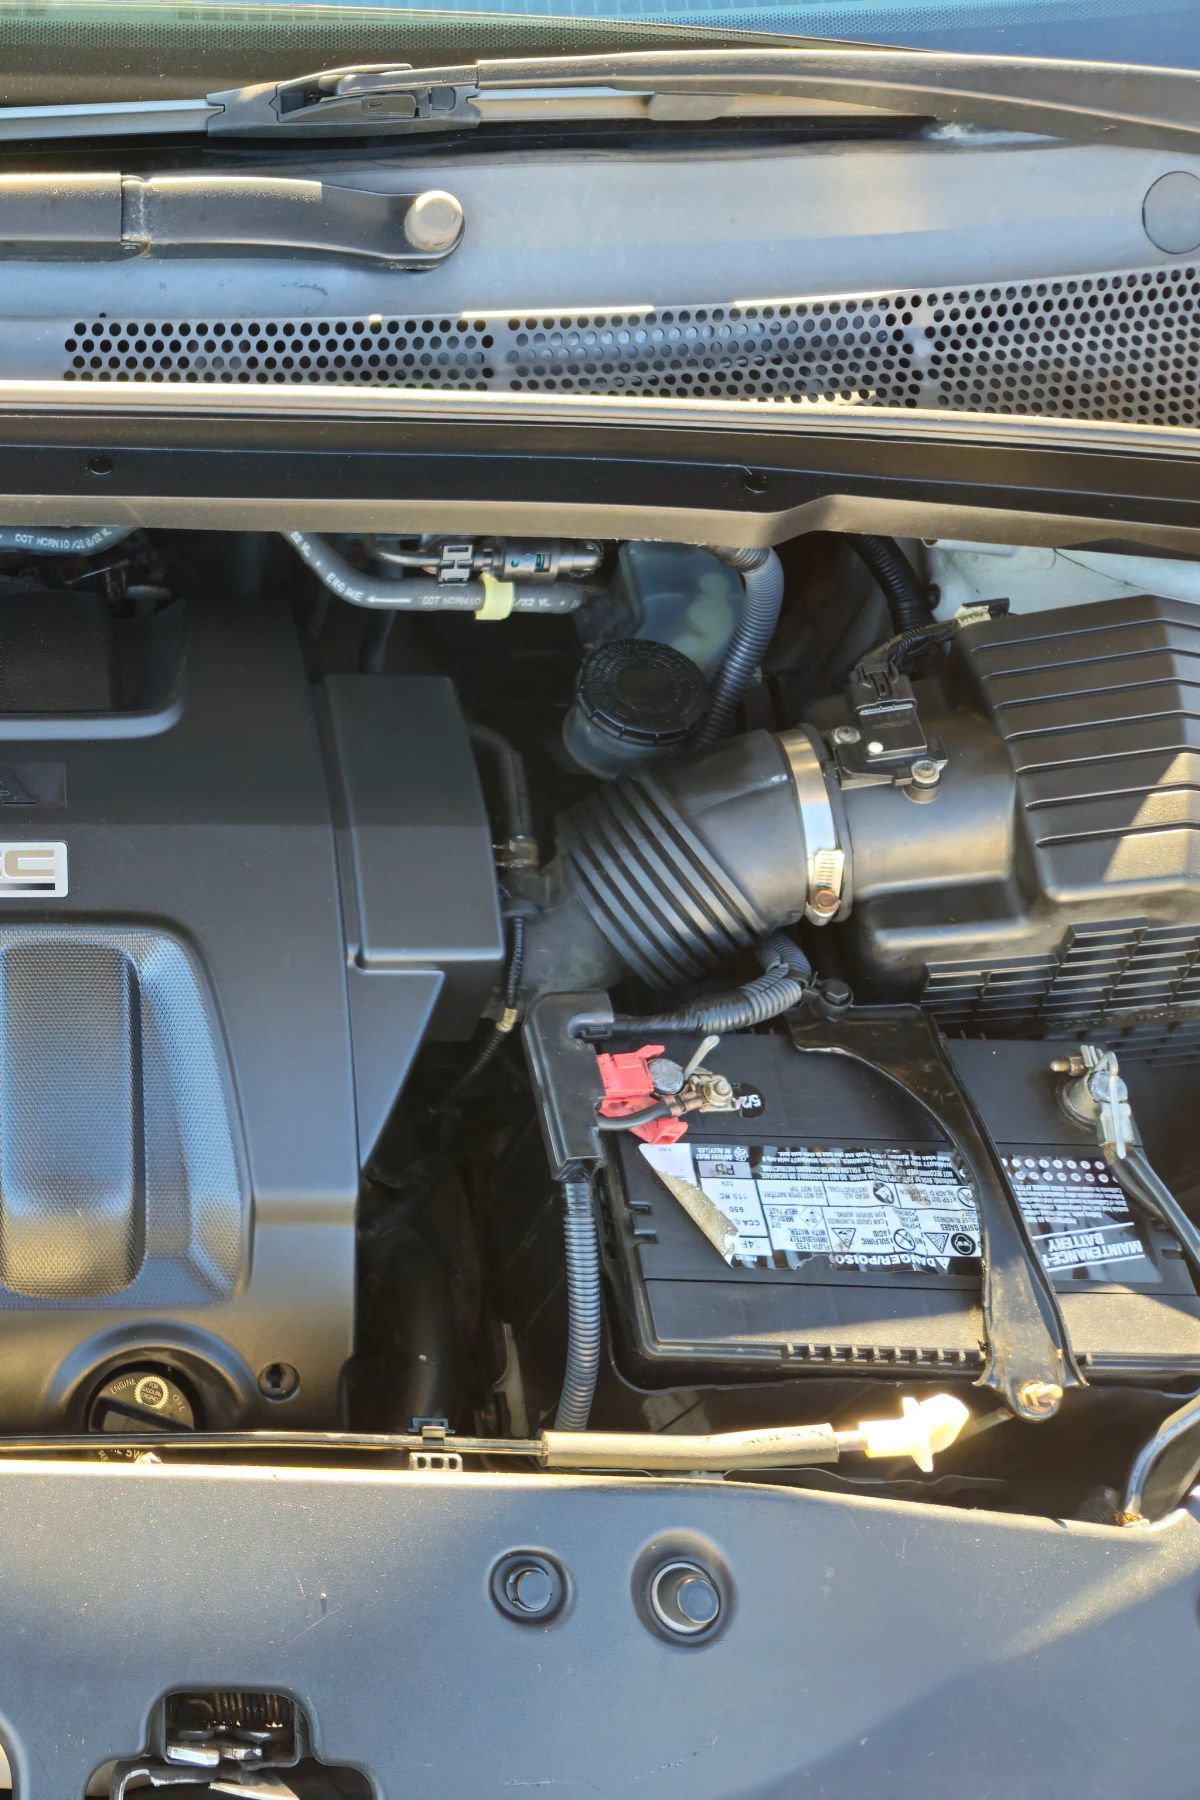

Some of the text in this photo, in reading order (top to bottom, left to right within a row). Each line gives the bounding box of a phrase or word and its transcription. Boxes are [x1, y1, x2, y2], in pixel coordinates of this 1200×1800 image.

[15, 533, 34, 544] DOT
[1048, 1232, 1105, 1253] BATTERY
[109, 1378, 137, 1394] ENGINE
[172, 1394, 185, 1413] OIL
